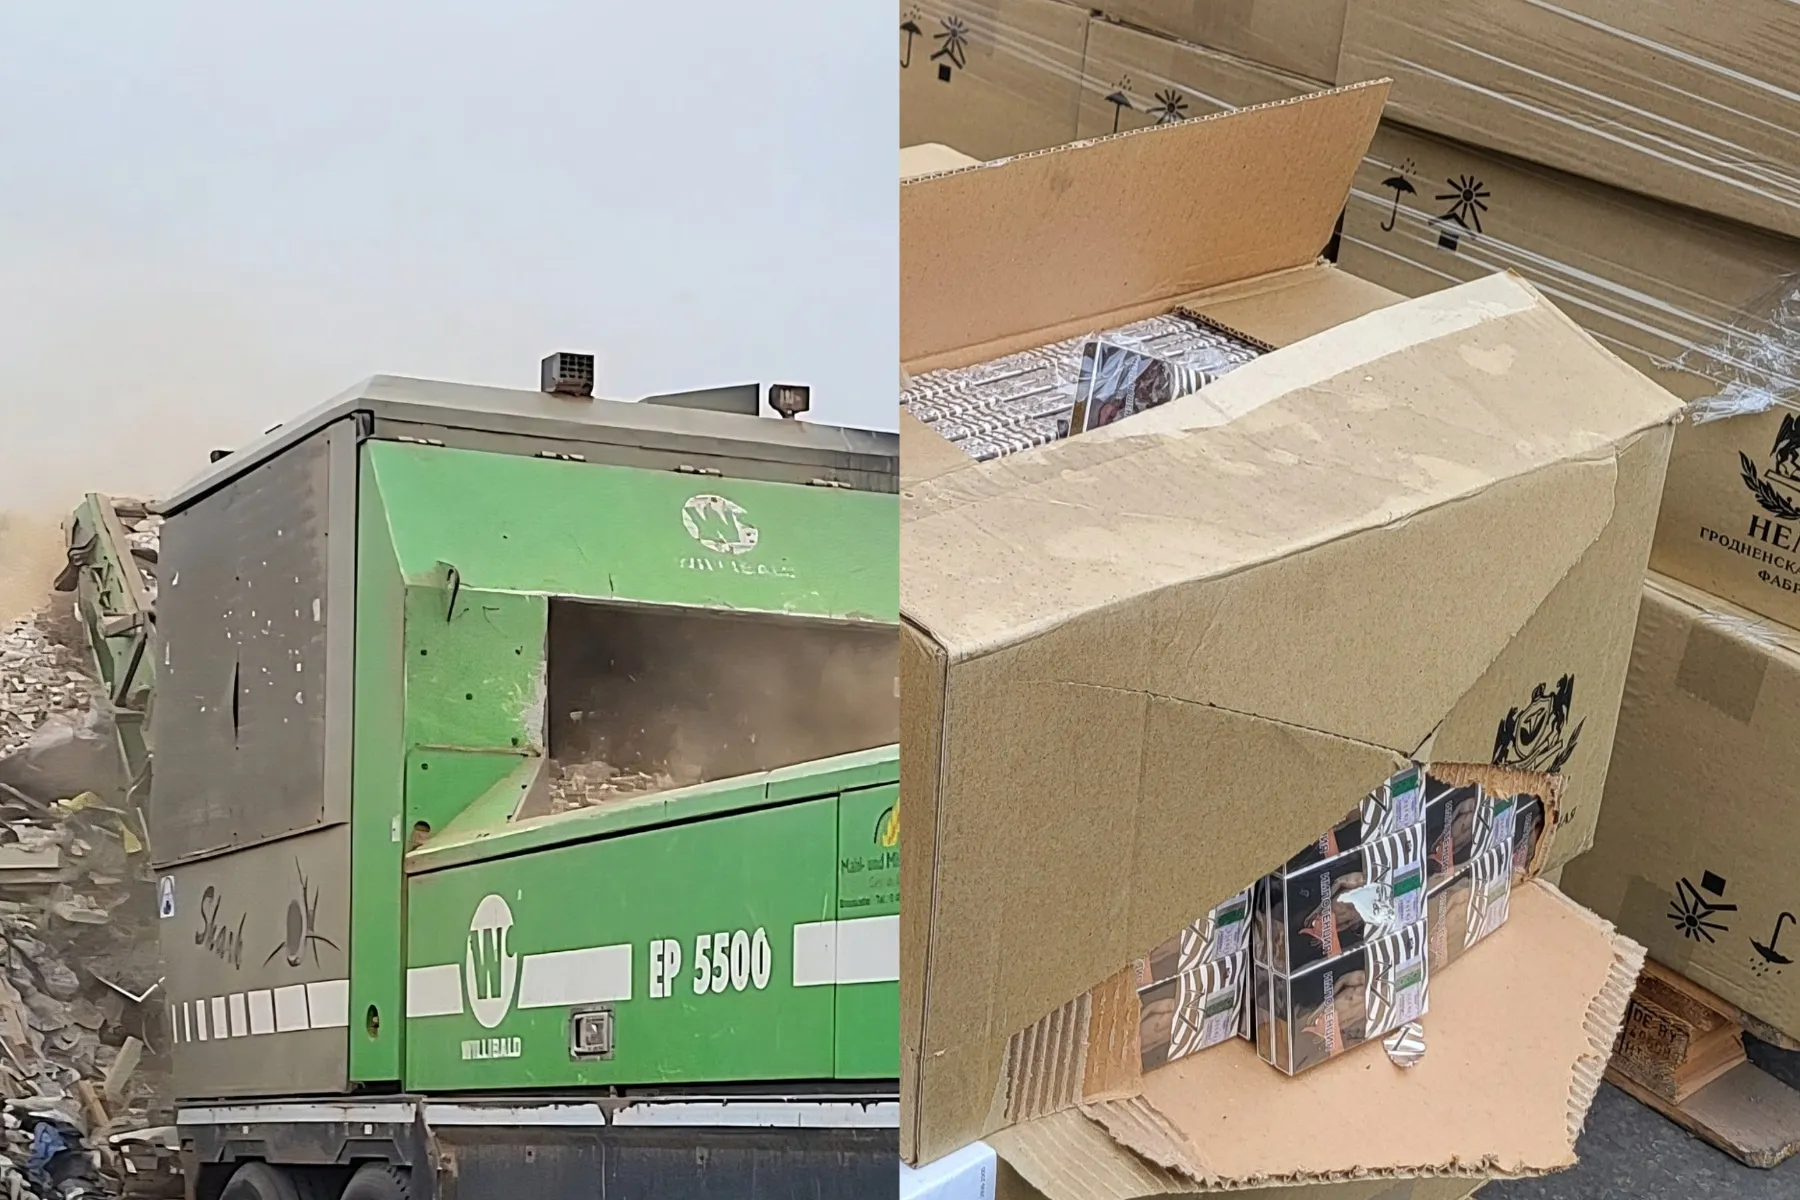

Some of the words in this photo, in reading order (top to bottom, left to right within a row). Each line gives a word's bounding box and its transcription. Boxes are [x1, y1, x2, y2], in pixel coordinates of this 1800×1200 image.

[1747, 514, 1800, 553] НЕ
[1758, 569, 1800, 594] ФАБР
[1320, 872, 1332, 955] ИМПОТЕНЦИЯ
[649, 938, 682, 999] EP
[693, 926, 772, 995] 5500
[1323, 970, 1335, 1053] ИМПОТЕНЦИЯ
[461, 1036, 522, 1060] WILLIBALD
